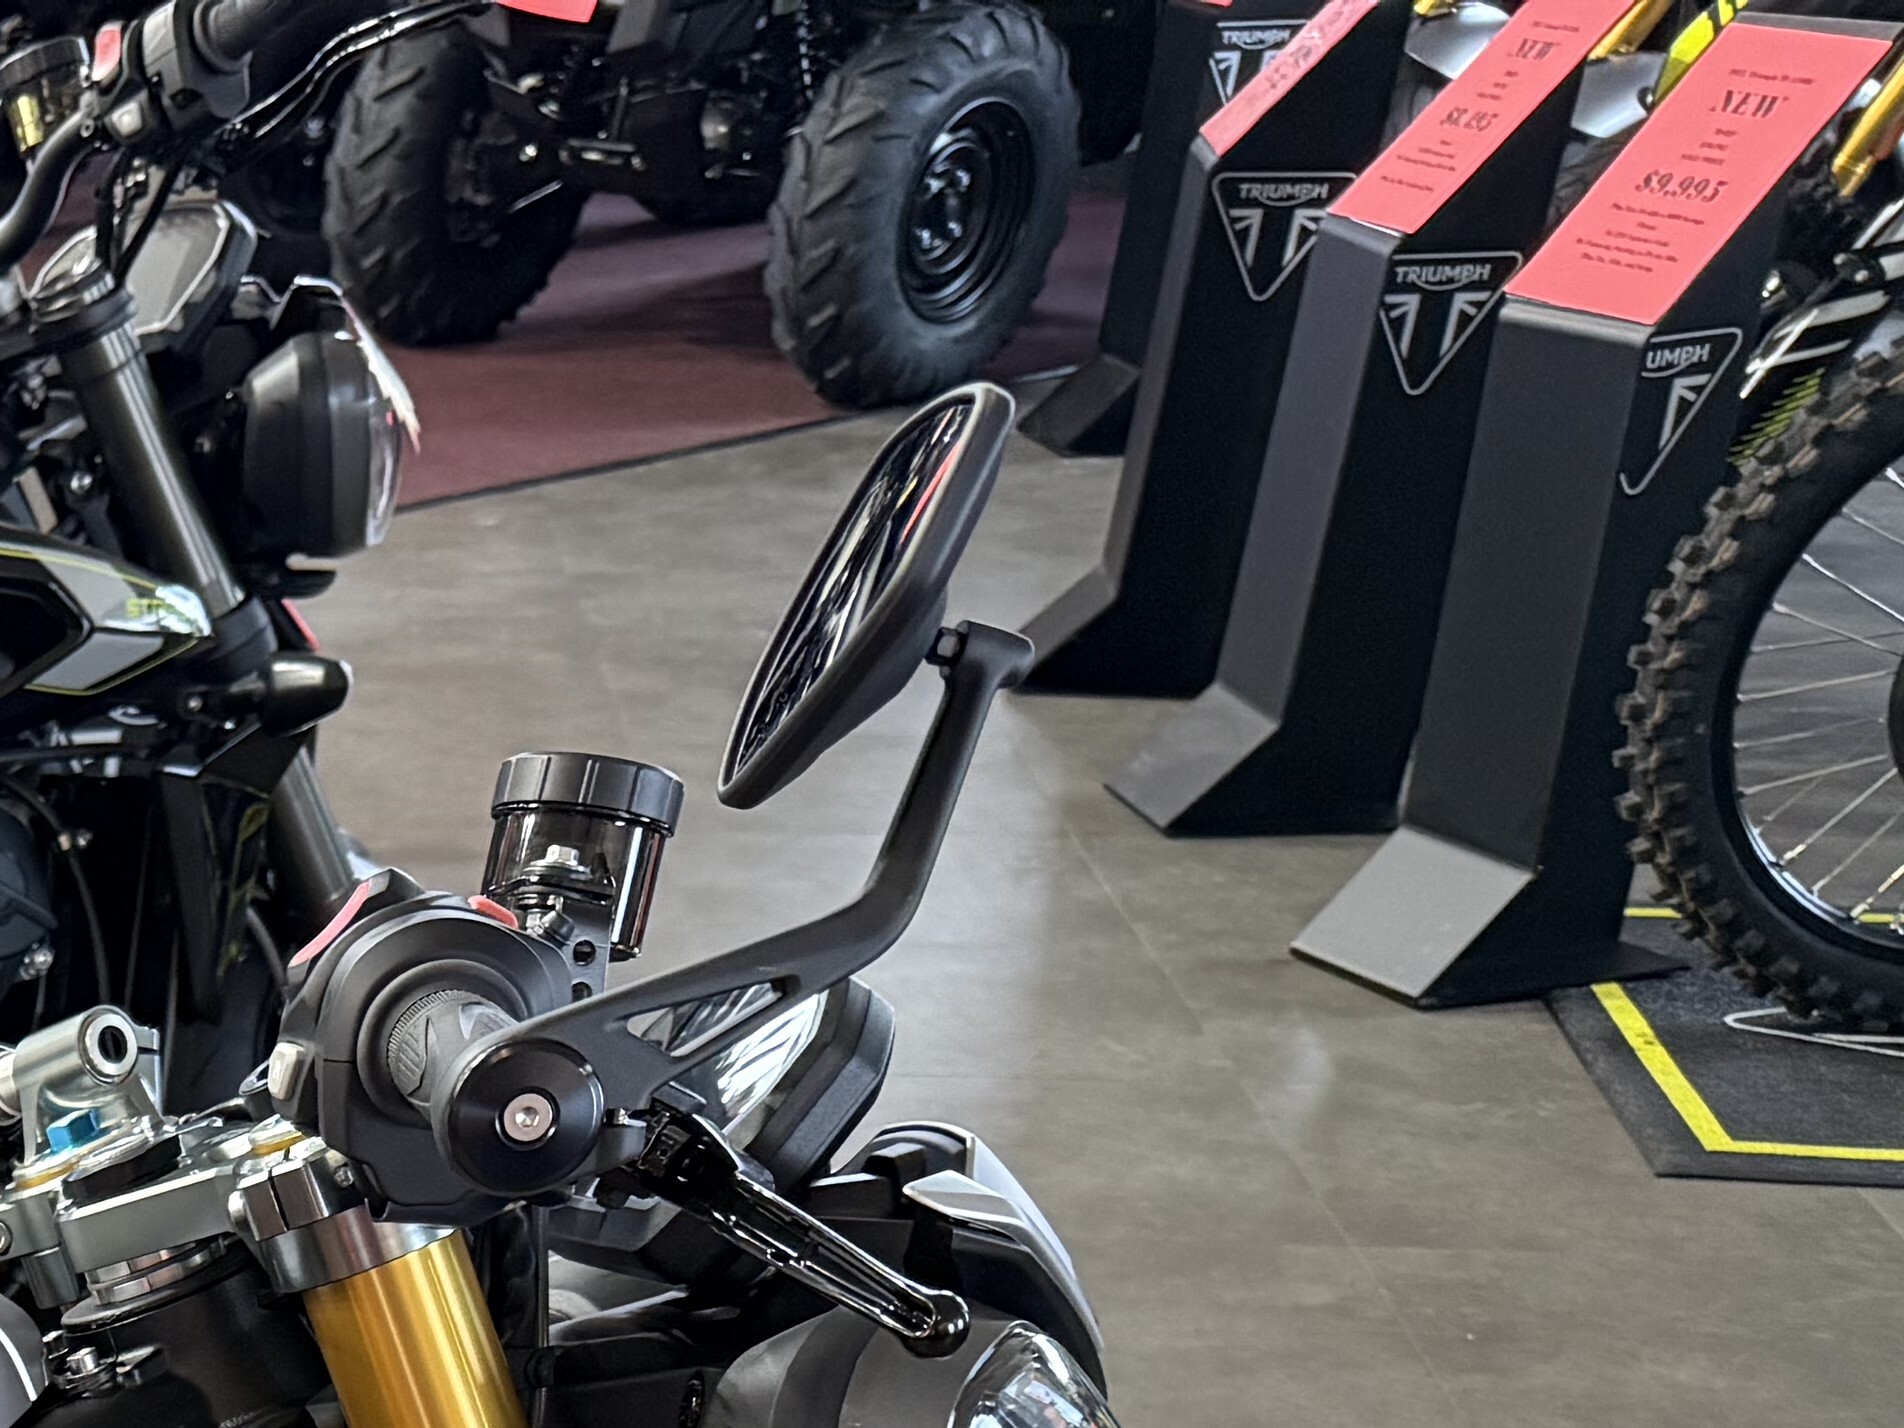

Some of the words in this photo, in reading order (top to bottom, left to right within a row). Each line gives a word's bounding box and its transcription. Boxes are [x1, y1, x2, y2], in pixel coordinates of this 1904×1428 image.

[1709, 89, 1790, 118] NEW
[1239, 182, 1329, 200] TRIUMPH
[1635, 169, 1728, 203] $9,995
[1395, 263, 1492, 283] TRIUMPH
[1645, 344, 1711, 368] UMPH
